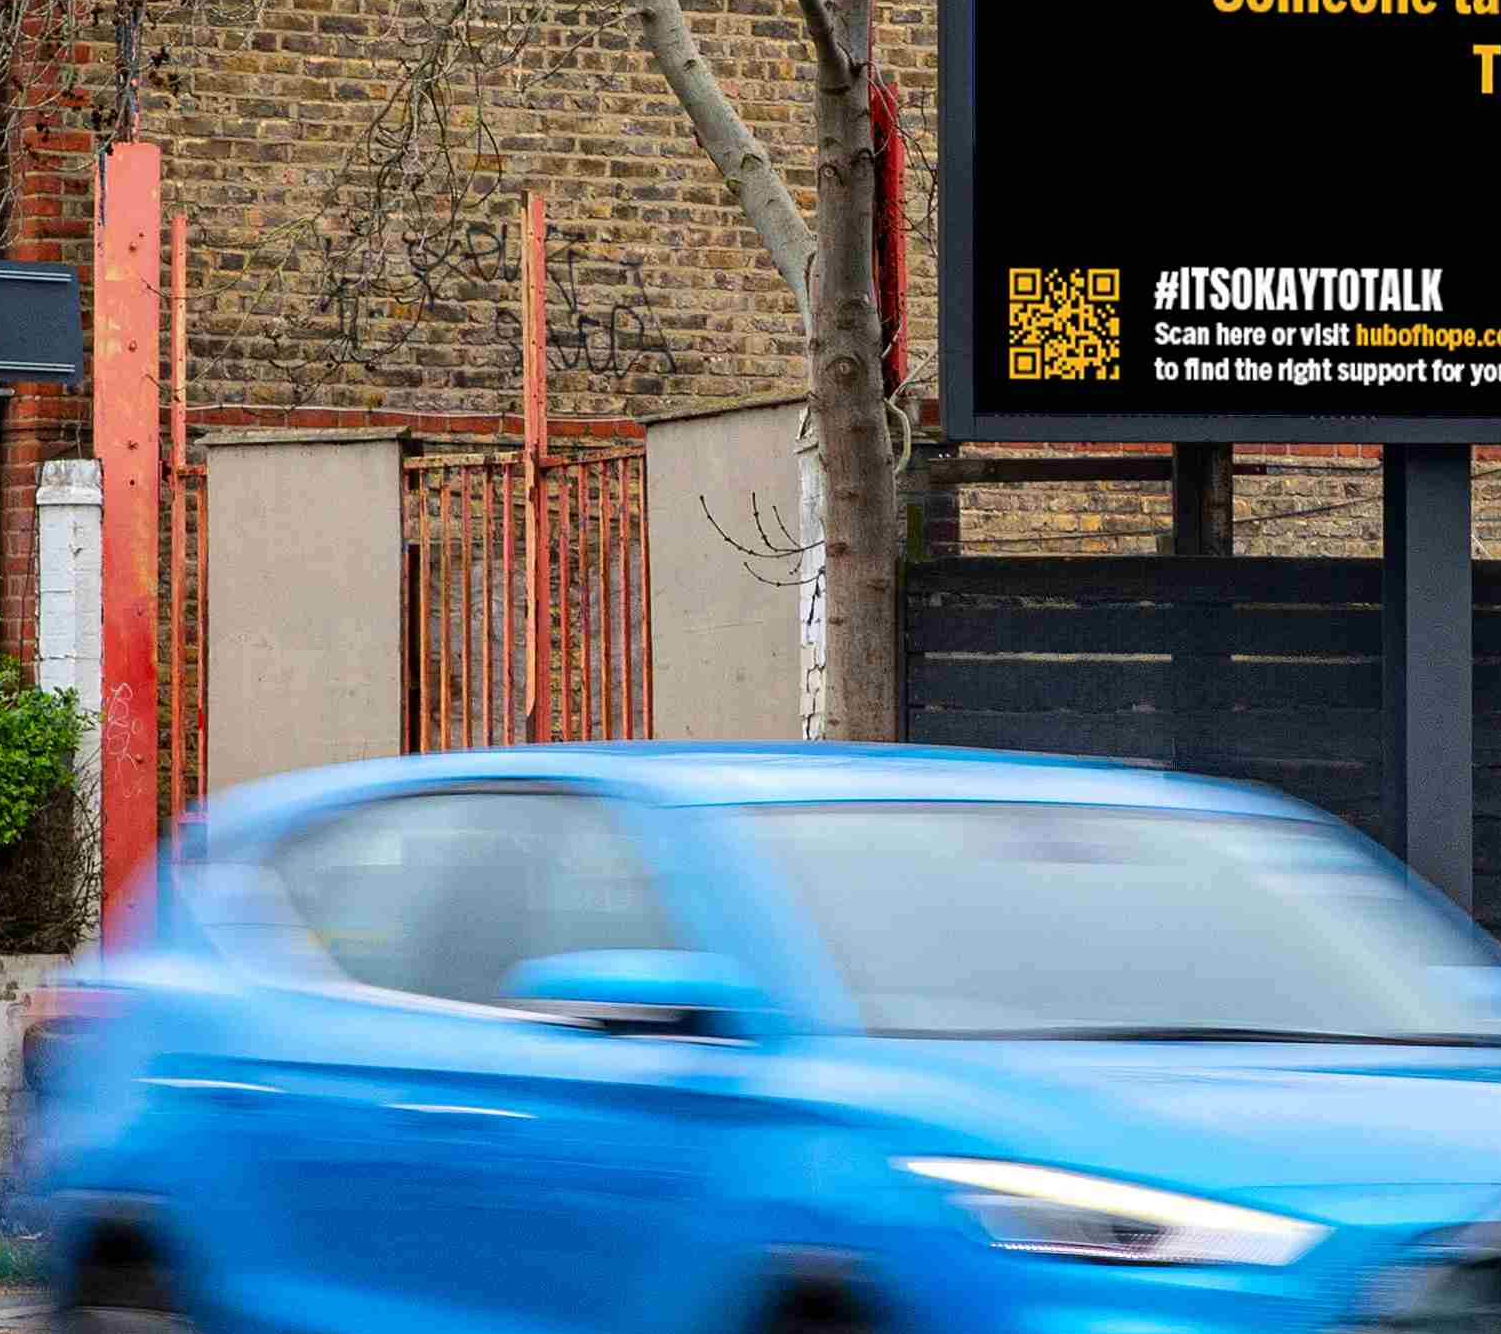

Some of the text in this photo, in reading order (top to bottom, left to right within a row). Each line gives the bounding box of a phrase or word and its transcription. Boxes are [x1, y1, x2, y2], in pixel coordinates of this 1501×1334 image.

[1154, 266, 1444, 312] #ITSOKAYTOTALK
[1154, 321, 1210, 346] Scan
[1215, 321, 1267, 346] here
[1271, 326, 1297, 347] or
[1299, 322, 1351, 347] visit
[1153, 356, 1179, 381] to
[1183, 357, 1230, 381] find
[1234, 357, 1273, 382] the
[1278, 357, 1333, 386] right
[1337, 358, 1428, 387] support
[1431, 358, 1466, 383] for
